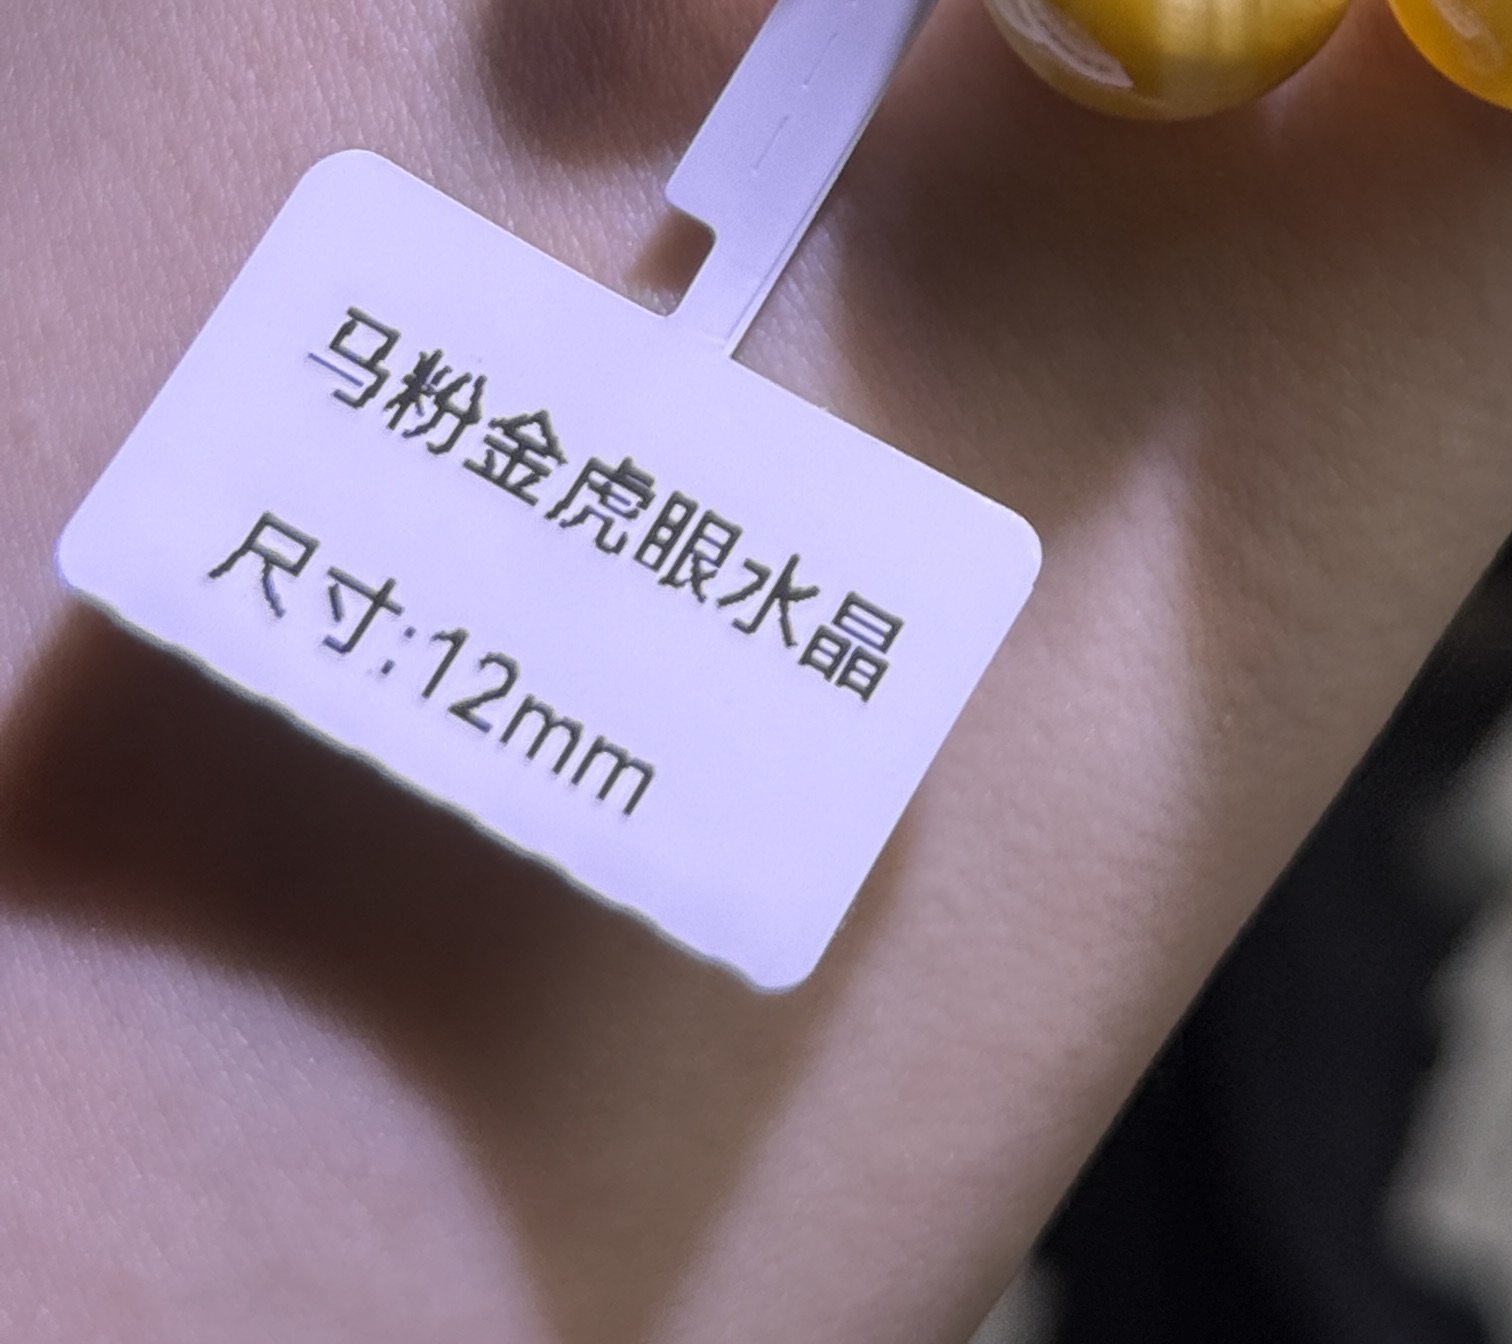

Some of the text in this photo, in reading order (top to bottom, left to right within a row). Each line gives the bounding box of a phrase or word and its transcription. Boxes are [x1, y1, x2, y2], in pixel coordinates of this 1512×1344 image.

[207, 512, 656, 817] 尺寸:12mm
[307, 306, 905, 704] 马粉金虎眼水晶
